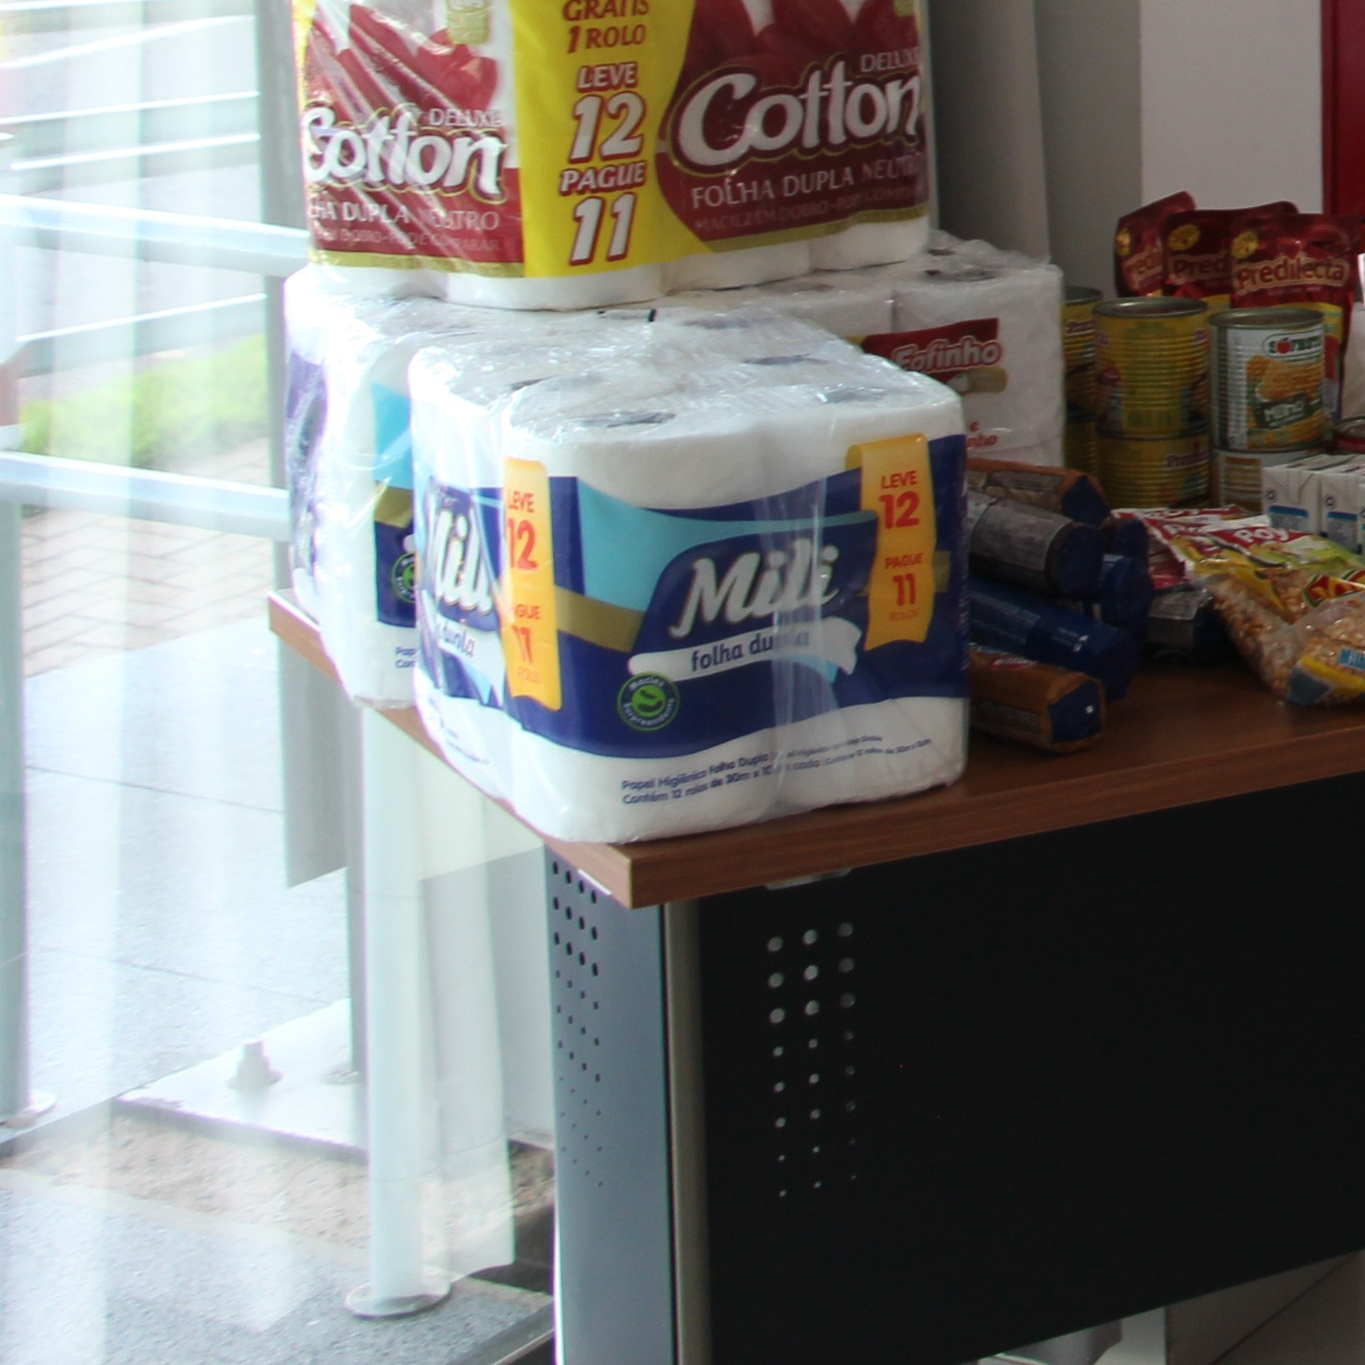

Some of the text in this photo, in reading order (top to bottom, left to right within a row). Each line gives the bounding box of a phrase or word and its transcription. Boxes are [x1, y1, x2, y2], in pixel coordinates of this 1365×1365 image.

[567, 24, 647, 53] 1 ROLO
[577, 62, 638, 92] LEVE
[430, 107, 504, 128] DELUXE
[569, 90, 647, 164] 12
[679, 61, 921, 167] Cotton
[301, 106, 507, 195] Cotton
[560, 161, 647, 195] PAGUE
[692, 167, 855, 210] FOLHA DUPLA
[342, 201, 410, 223] DUPLA
[569, 192, 637, 266] 11
[1237, 257, 1346, 291] Predilecta
[881, 470, 918, 490] LEVE
[507, 491, 535, 513] LEVE
[878, 490, 920, 529] 12
[507, 519, 538, 571] 12
[884, 552, 925, 571] PAGUE
[667, 537, 840, 639] Mili
[892, 572, 917, 607] 11
[691, 628, 810, 673] folha dua
[622, 752, 770, 792] Papel Higiênico Folha Dupla
[622, 790, 669, 805] Contém
[671, 788, 682, 800] 12
[709, 778, 724, 789] de
[726, 770, 750, 785] 30m
